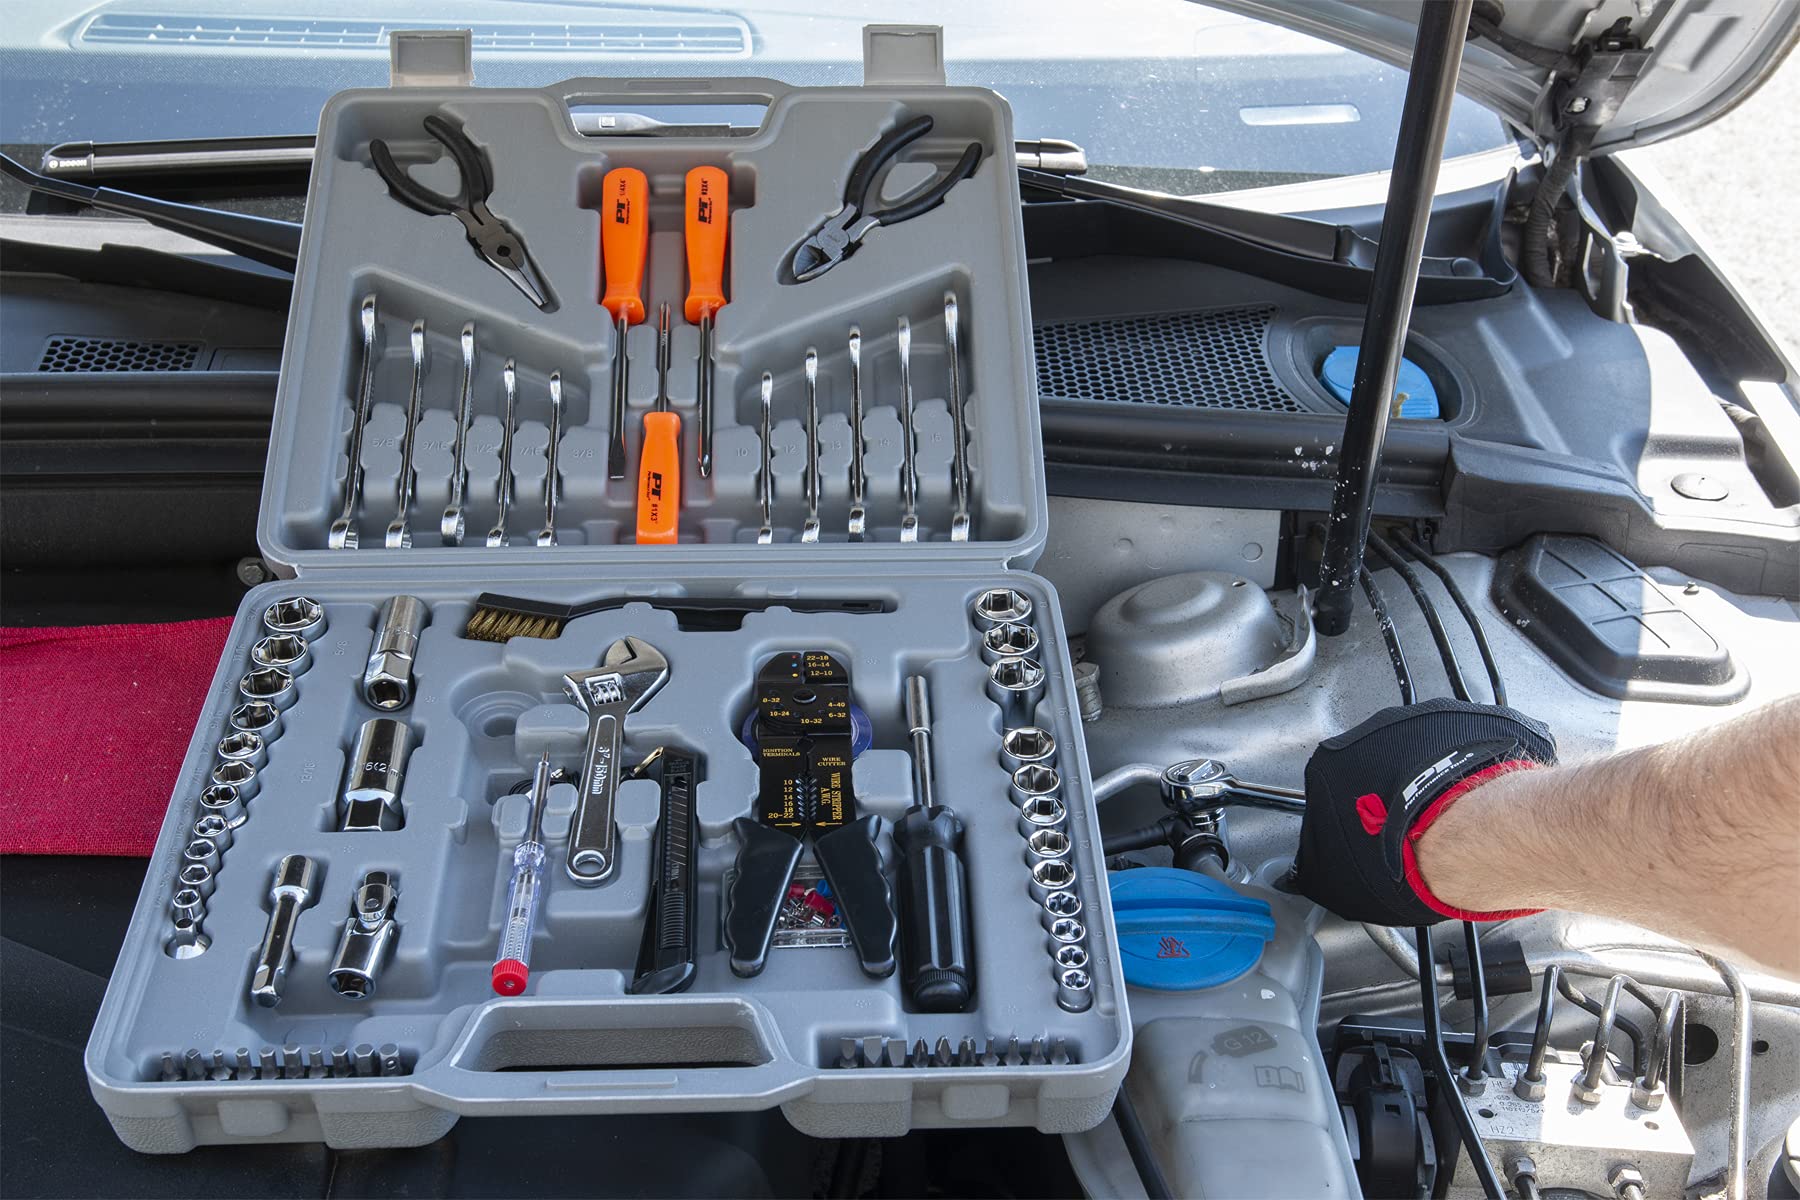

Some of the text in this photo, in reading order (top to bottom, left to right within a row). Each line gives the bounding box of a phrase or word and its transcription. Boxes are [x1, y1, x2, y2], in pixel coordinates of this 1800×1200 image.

[616, 198, 626, 224] PT
[698, 197, 709, 223] PT
[372, 438, 394, 448] 5/8
[573, 448, 593, 458] 3/8
[736, 448, 749, 457] 10
[784, 445, 797, 454] 12
[651, 471, 662, 500] PT
[1402, 750, 1459, 803] PT
[831, 772, 843, 820] WIRE STRIPPER
[1079, 839, 1090, 849] 12
[1088, 902, 1099, 912] 10
